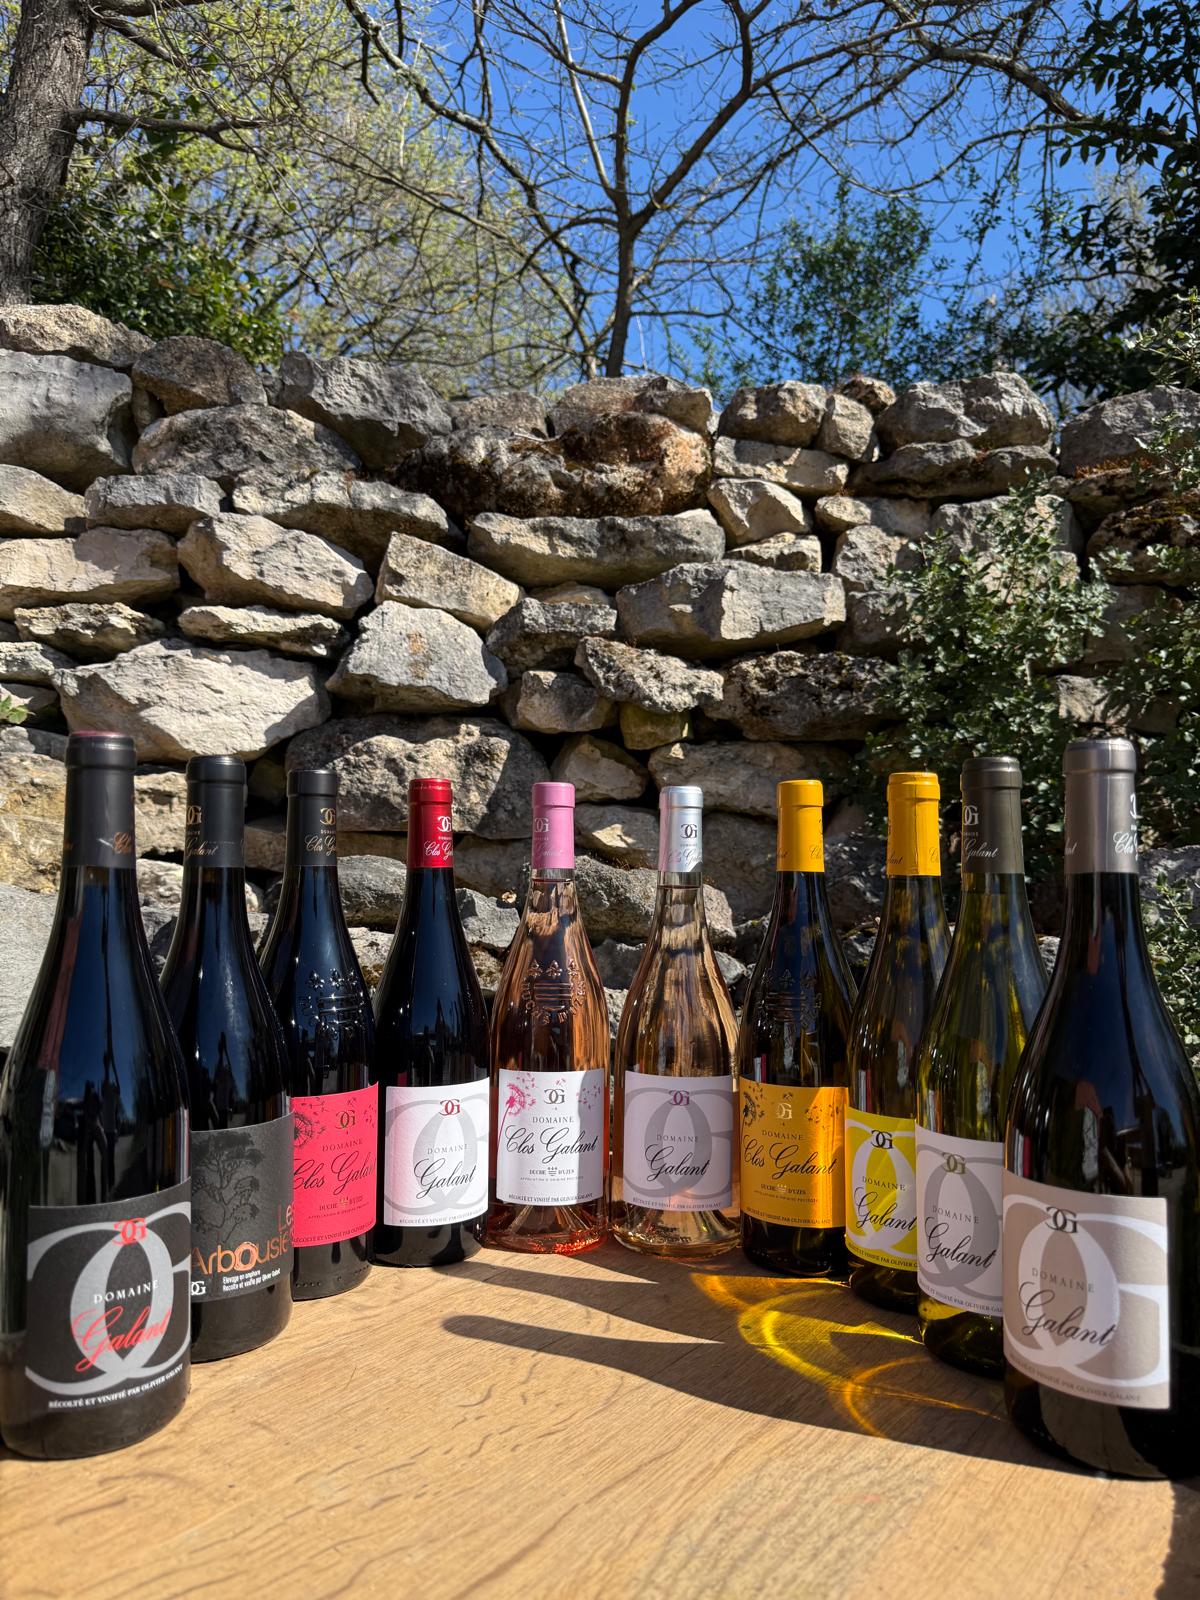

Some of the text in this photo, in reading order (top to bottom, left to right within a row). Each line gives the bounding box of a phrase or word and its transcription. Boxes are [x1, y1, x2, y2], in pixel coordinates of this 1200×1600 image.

[304, 834, 323, 851] Clos
[532, 1116, 574, 1124] DOMAINE
[322, 1138, 363, 1153] DOMAINE
[504, 1124, 599, 1164] Clos Galant
[656, 1134, 699, 1143] DOMAINE
[762, 1130, 804, 1141] DOMAINE
[427, 1143, 468, 1155] DOMAINE
[743, 1134, 838, 1180] Clos Galant
[294, 1158, 325, 1190] Clos
[644, 1143, 711, 1182] Galant
[414, 1157, 477, 1200] Galant
[862, 1175, 906, 1192] DOMAINE
[853, 1186, 917, 1232] Galant
[932, 1205, 980, 1225] DOMAINE
[924, 1216, 998, 1269] Galant
[93, 1280, 160, 1305] DOMAINE
[1031, 1267, 1095, 1294] DOMAINE
[1019, 1281, 1118, 1346] Galant
[71, 1305, 172, 1373] Galant
[85, 1396, 97, 1407] ET
[127, 1386, 142, 1398] PAR
